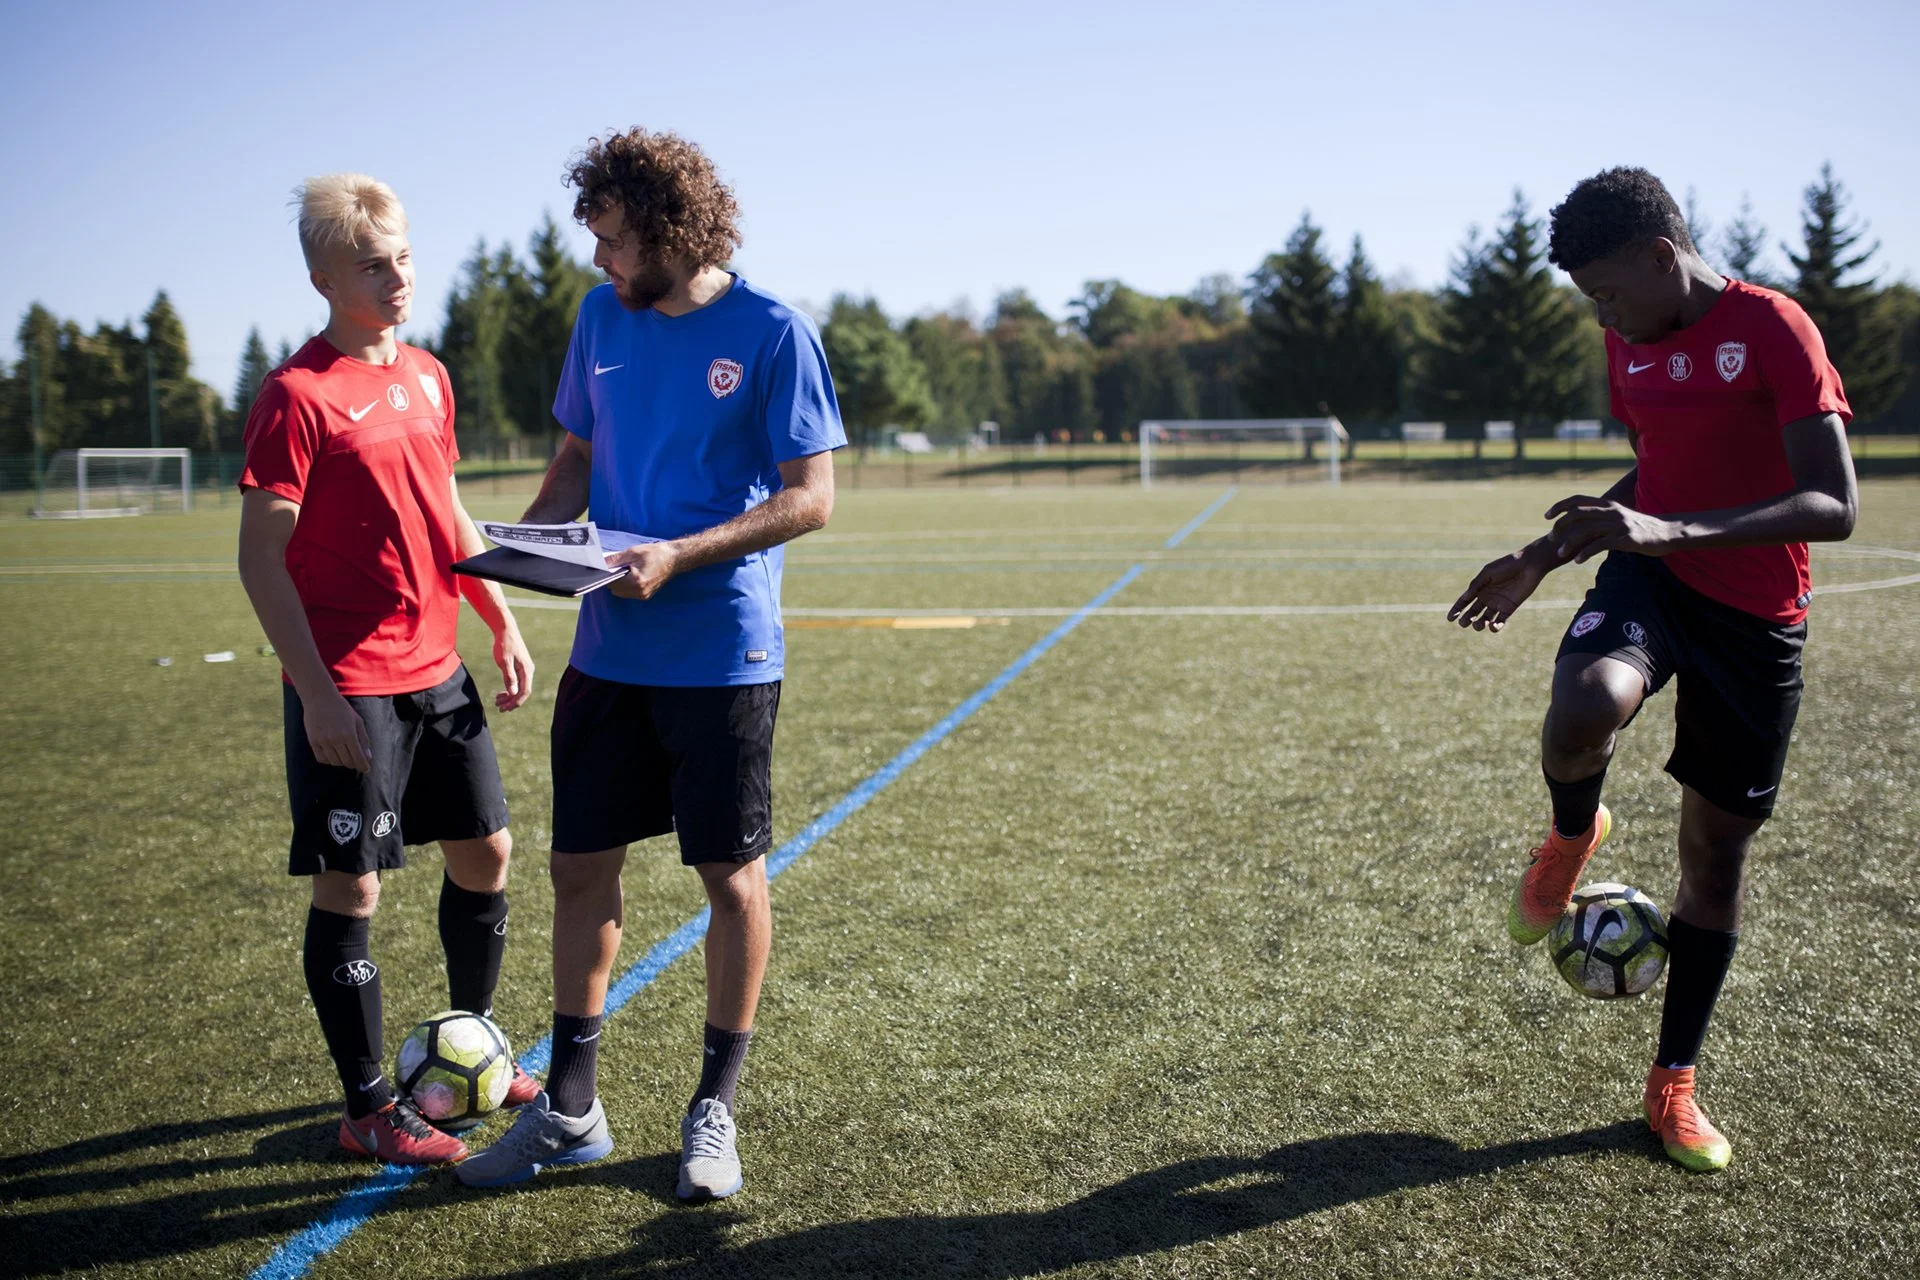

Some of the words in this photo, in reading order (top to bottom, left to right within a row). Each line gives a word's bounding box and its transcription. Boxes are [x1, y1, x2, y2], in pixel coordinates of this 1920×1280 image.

[1721, 346, 1743, 356] ASNL
[1672, 355, 1686, 367] CW
[715, 362, 740, 374] ASNL
[1672, 366, 1687, 378] 2001
[334, 812, 359, 823] ASNL
[348, 961, 367, 974] LC
[346, 968, 370, 984] 2001
